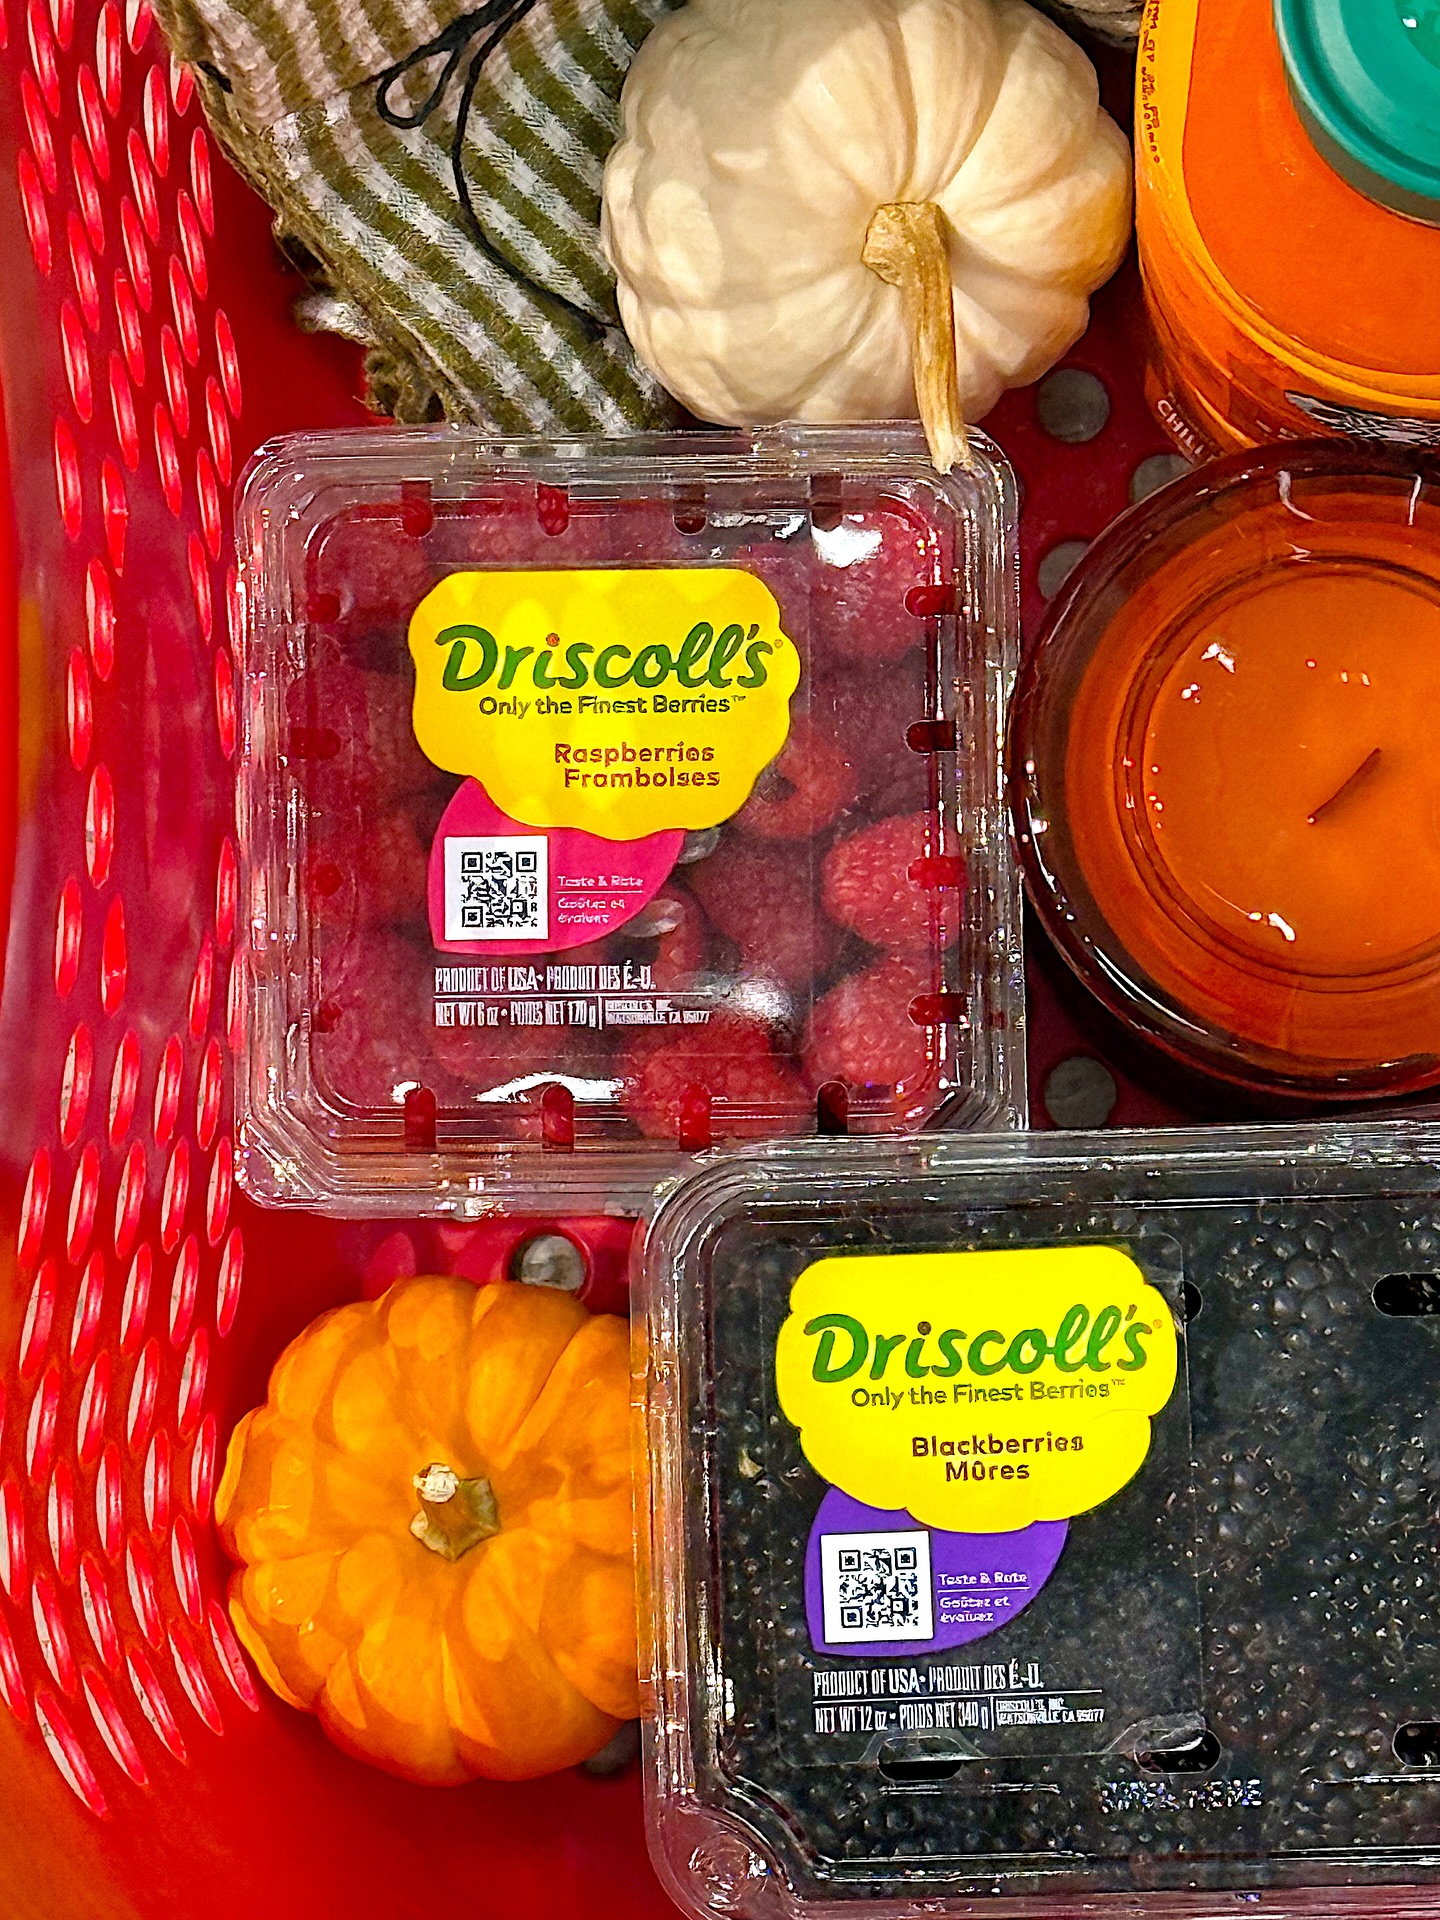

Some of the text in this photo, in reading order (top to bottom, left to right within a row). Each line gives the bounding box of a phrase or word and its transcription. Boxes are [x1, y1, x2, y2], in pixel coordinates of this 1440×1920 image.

[479, 695, 531, 719] Only
[535, 695, 572, 714] the
[577, 695, 648, 714] Finest
[554, 741, 715, 767] Raspberries
[557, 875, 595, 887] Taste
[611, 875, 643, 887] Rate
[434, 966, 488, 992] PRODUCT
[491, 966, 506, 991] OF
[546, 965, 597, 991] PRODUIT
[598, 965, 620, 990] DES
[435, 1001, 458, 1026] NET
[459, 1001, 477, 1026] WT
[477, 1001, 485, 1026] 6
[487, 1006, 499, 1026] oz
[510, 1001, 543, 1026] POIDS
[544, 1000, 567, 1025] NET
[568, 1000, 587, 1025] 170
[851, 1385, 903, 1411] Only
[907, 1384, 948, 1404] the
[953, 1382, 1024, 1403] Finest
[911, 1432, 1085, 1458] Blackberries
[937, 1573, 977, 1586] Taste
[994, 1571, 1028, 1583] Rate
[994, 1596, 1012, 1607] et
[813, 1669, 868, 1696] PRODUCT
[871, 1668, 887, 1694] OF
[928, 1665, 981, 1692] PRODUIT
[983, 1664, 1006, 1691] DES
[815, 1706, 837, 1734] NET
[839, 1705, 859, 1732] WT
[860, 1705, 874, 1732] 12
[874, 1710, 888, 1731] oz
[899, 1702, 933, 1731] POIDS
[935, 1701, 956, 1728] NET
[957, 1701, 978, 1728] 340
